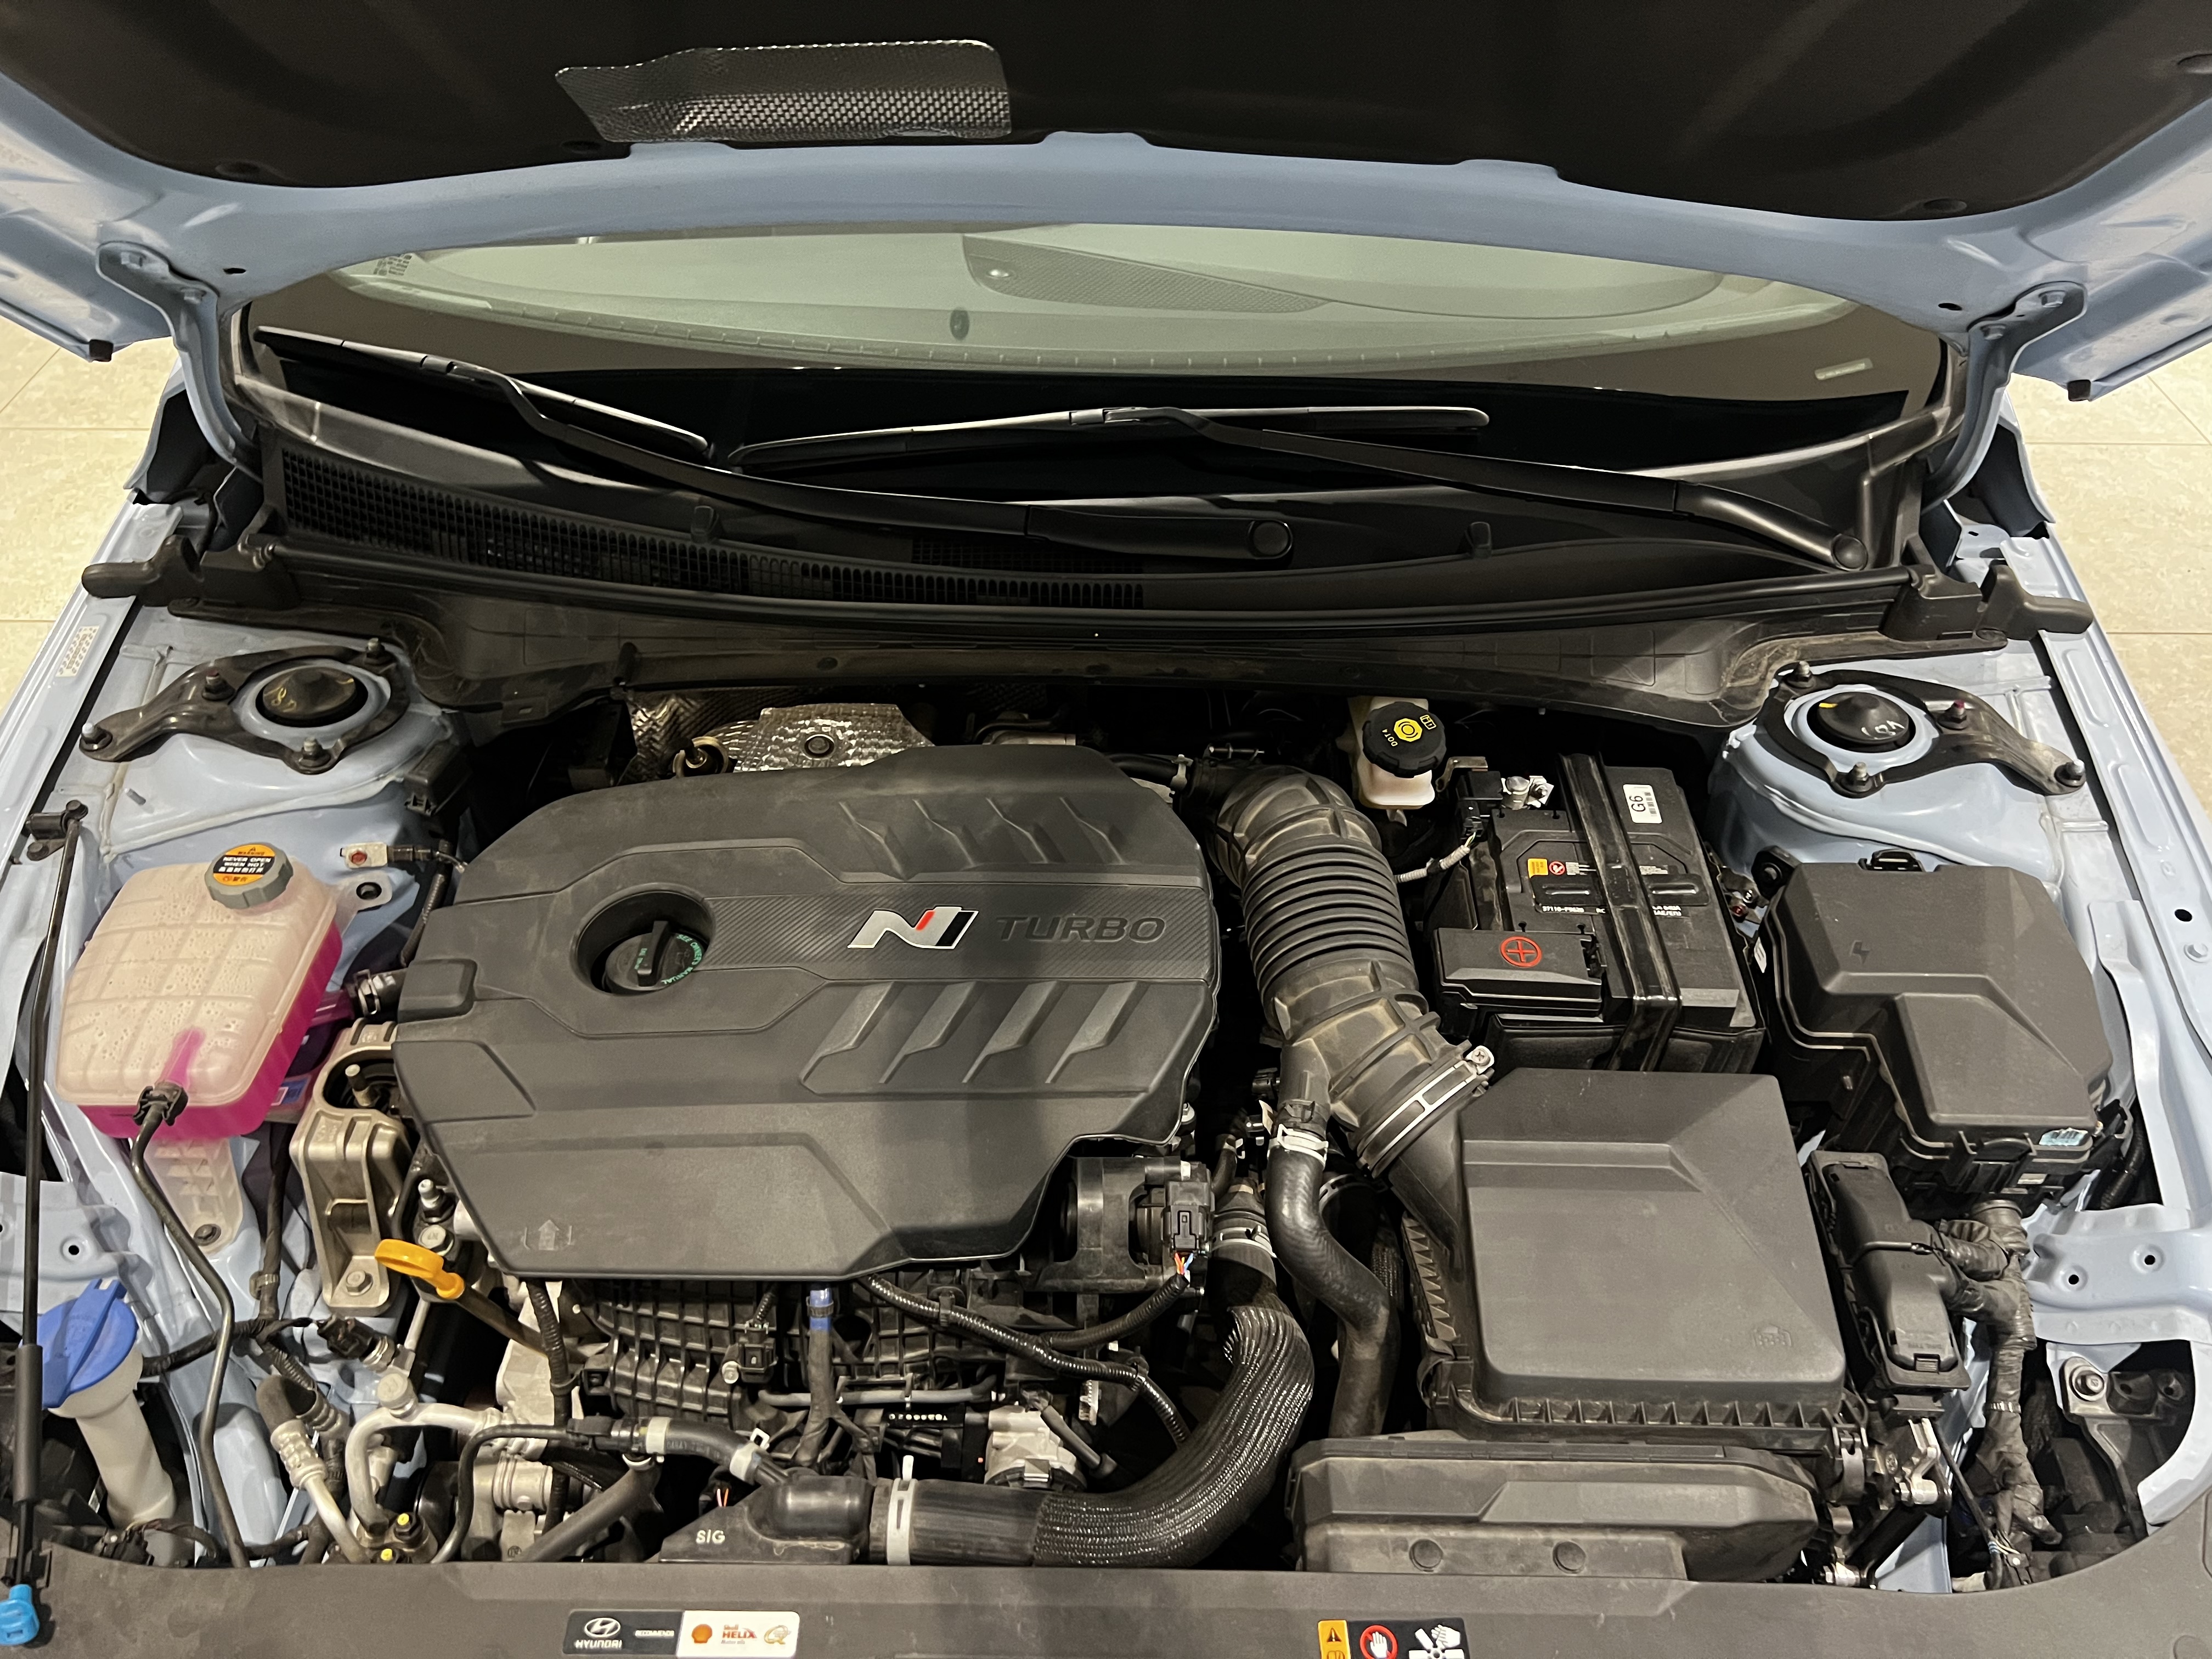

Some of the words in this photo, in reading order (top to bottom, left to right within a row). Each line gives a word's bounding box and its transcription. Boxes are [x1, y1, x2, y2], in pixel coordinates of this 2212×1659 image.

[1382, 729, 1398, 747] DOT4
[1629, 795, 1646, 812] G6
[996, 916, 1166, 943] TURBO
[676, 934, 693, 943] SEE
[722, 1630, 758, 1639] HELIX
[574, 1639, 623, 1649] HYUNDAI
